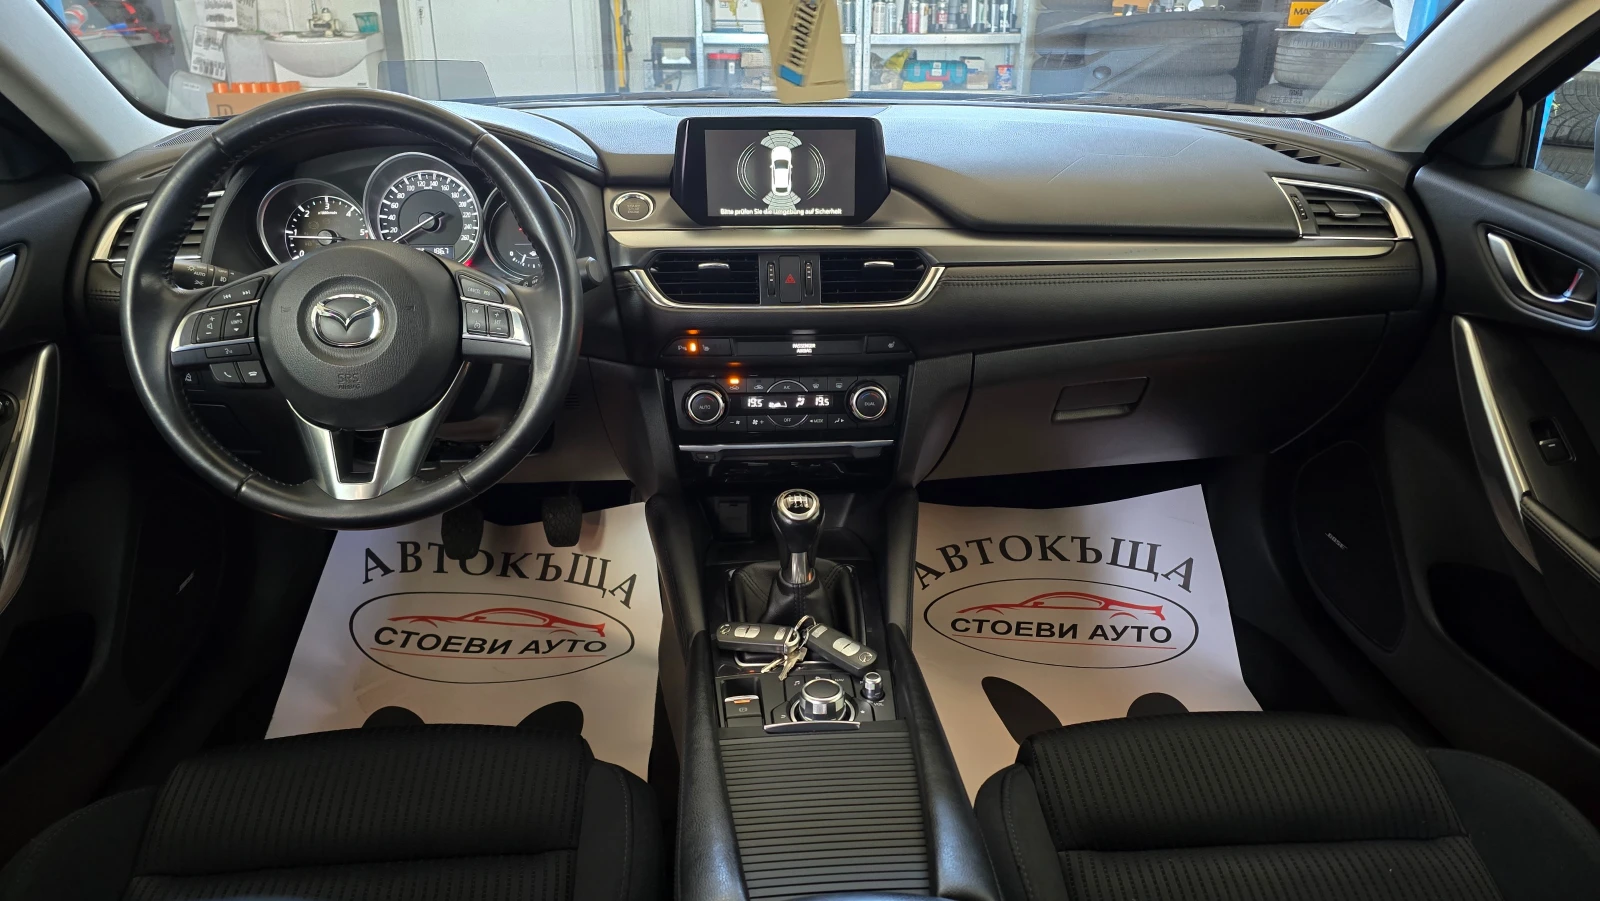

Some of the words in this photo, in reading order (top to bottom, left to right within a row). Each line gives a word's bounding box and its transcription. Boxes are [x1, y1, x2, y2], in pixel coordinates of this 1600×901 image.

[815, 207, 842, 215] Sicherheit
[747, 396, 763, 408] 19.5
[815, 396, 830, 406] 19.5
[362, 540, 638, 609] АВТОКЪЩА
[914, 535, 1195, 593] АВТОКЪЩА
[373, 626, 513, 655] СТОЕВИ
[518, 638, 607, 655] АУТО
[950, 617, 1079, 639] СТОЕВИ
[1088, 624, 1172, 644] АУТО
